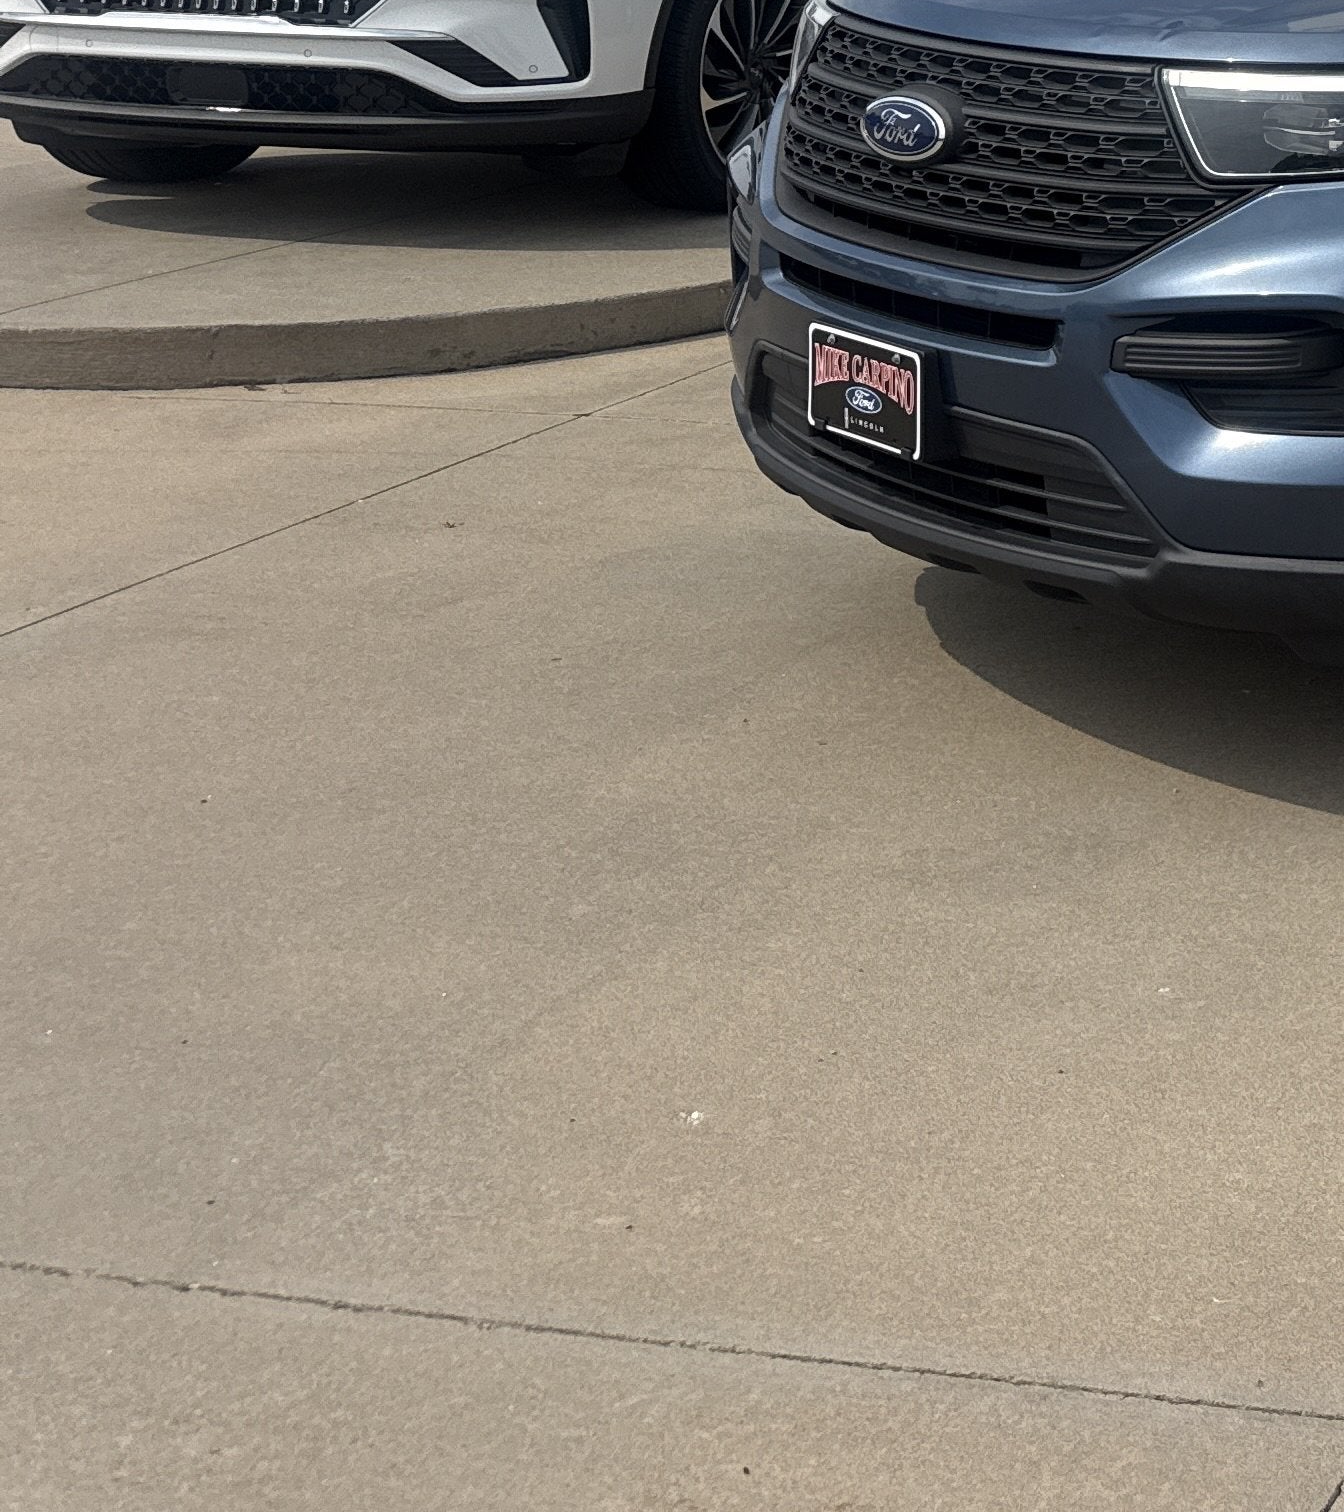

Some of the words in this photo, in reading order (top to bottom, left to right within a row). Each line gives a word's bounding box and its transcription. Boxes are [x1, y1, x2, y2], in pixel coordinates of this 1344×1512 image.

[873, 107, 921, 147] Ford
[814, 342, 849, 386] MIKE
[852, 355, 915, 415] CARPINO
[852, 389, 875, 410] Ford
[850, 416, 884, 433] LINCOLN
